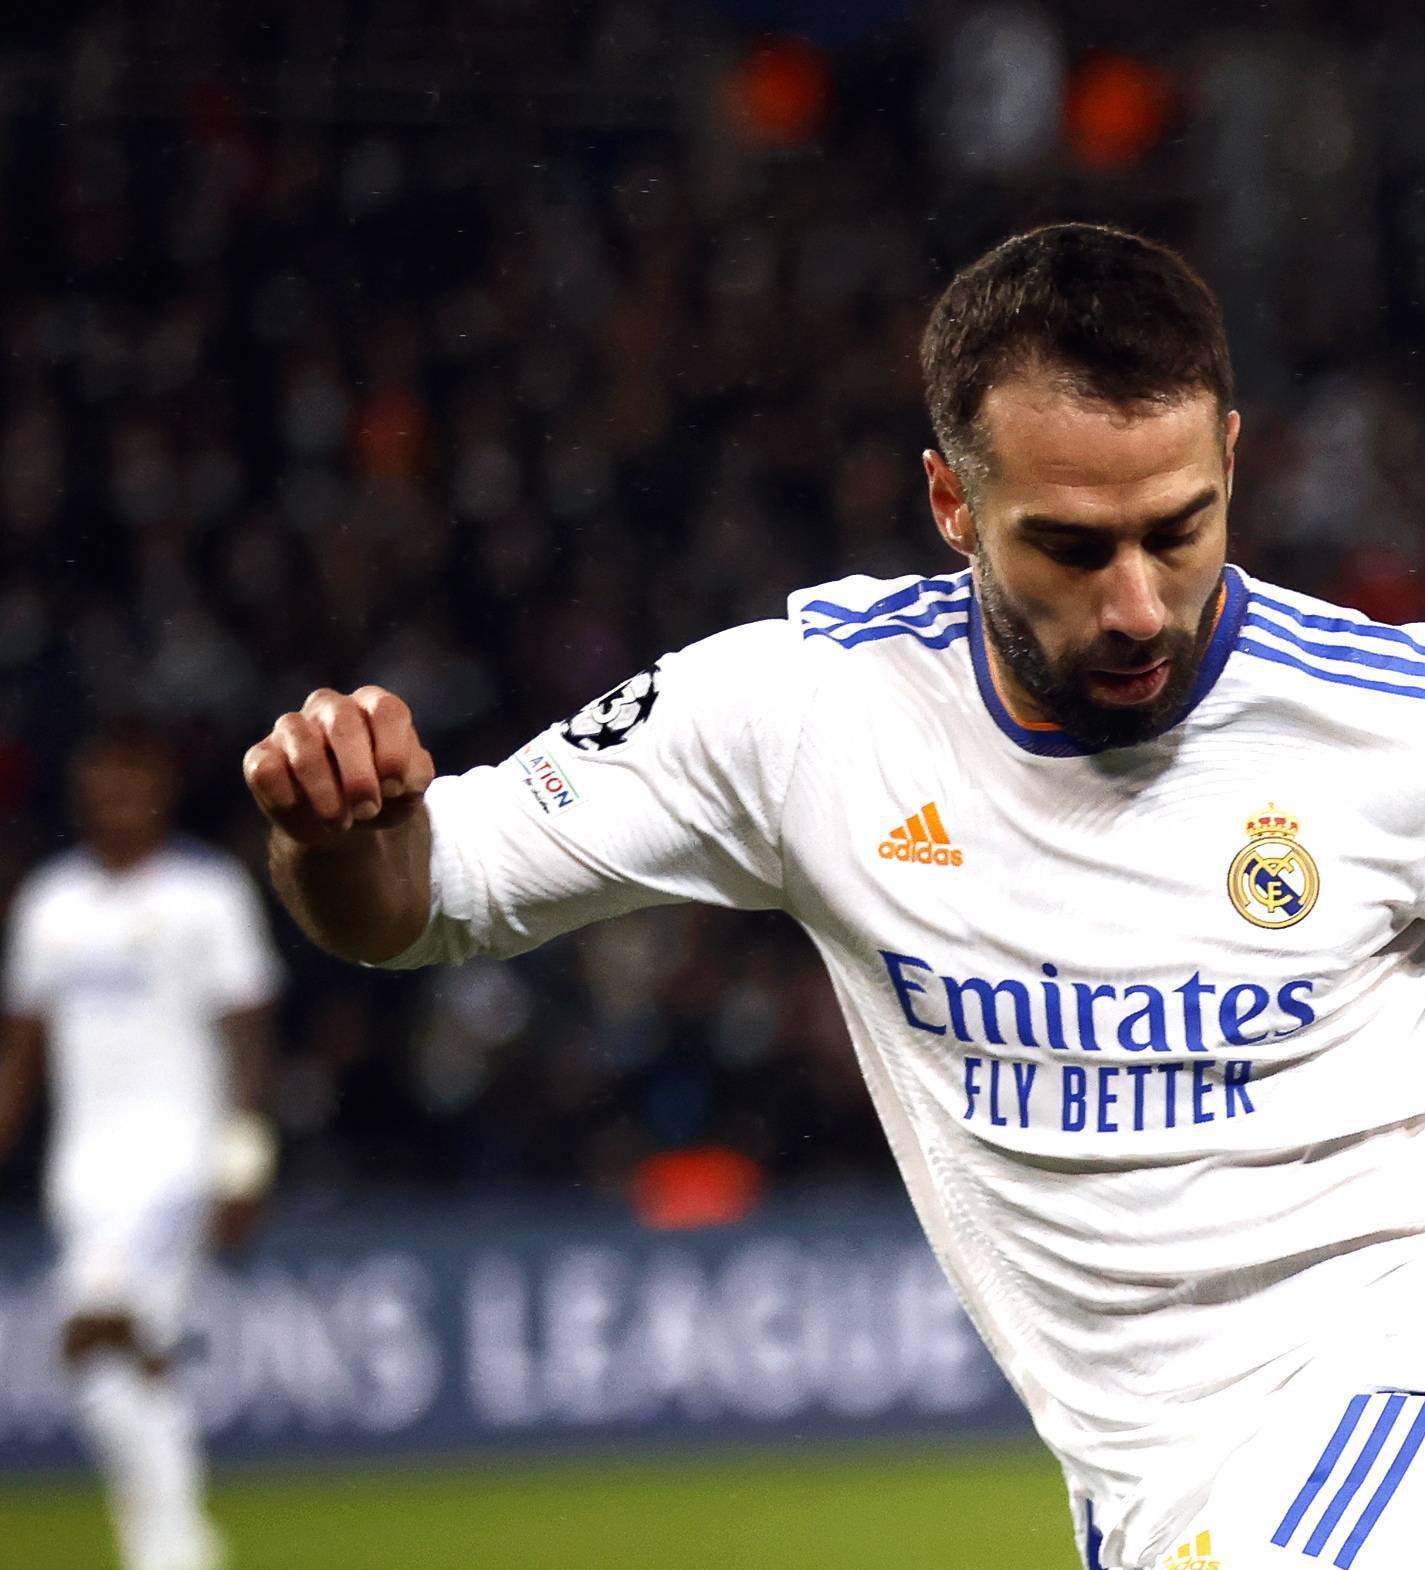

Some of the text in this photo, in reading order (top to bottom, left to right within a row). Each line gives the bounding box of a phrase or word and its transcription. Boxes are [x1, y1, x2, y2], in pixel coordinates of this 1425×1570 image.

[527, 751, 574, 808] ATION
[879, 841, 964, 867] adidas
[879, 950, 1316, 1052] Emirates
[964, 1058, 1256, 1134] FLY BETTER
